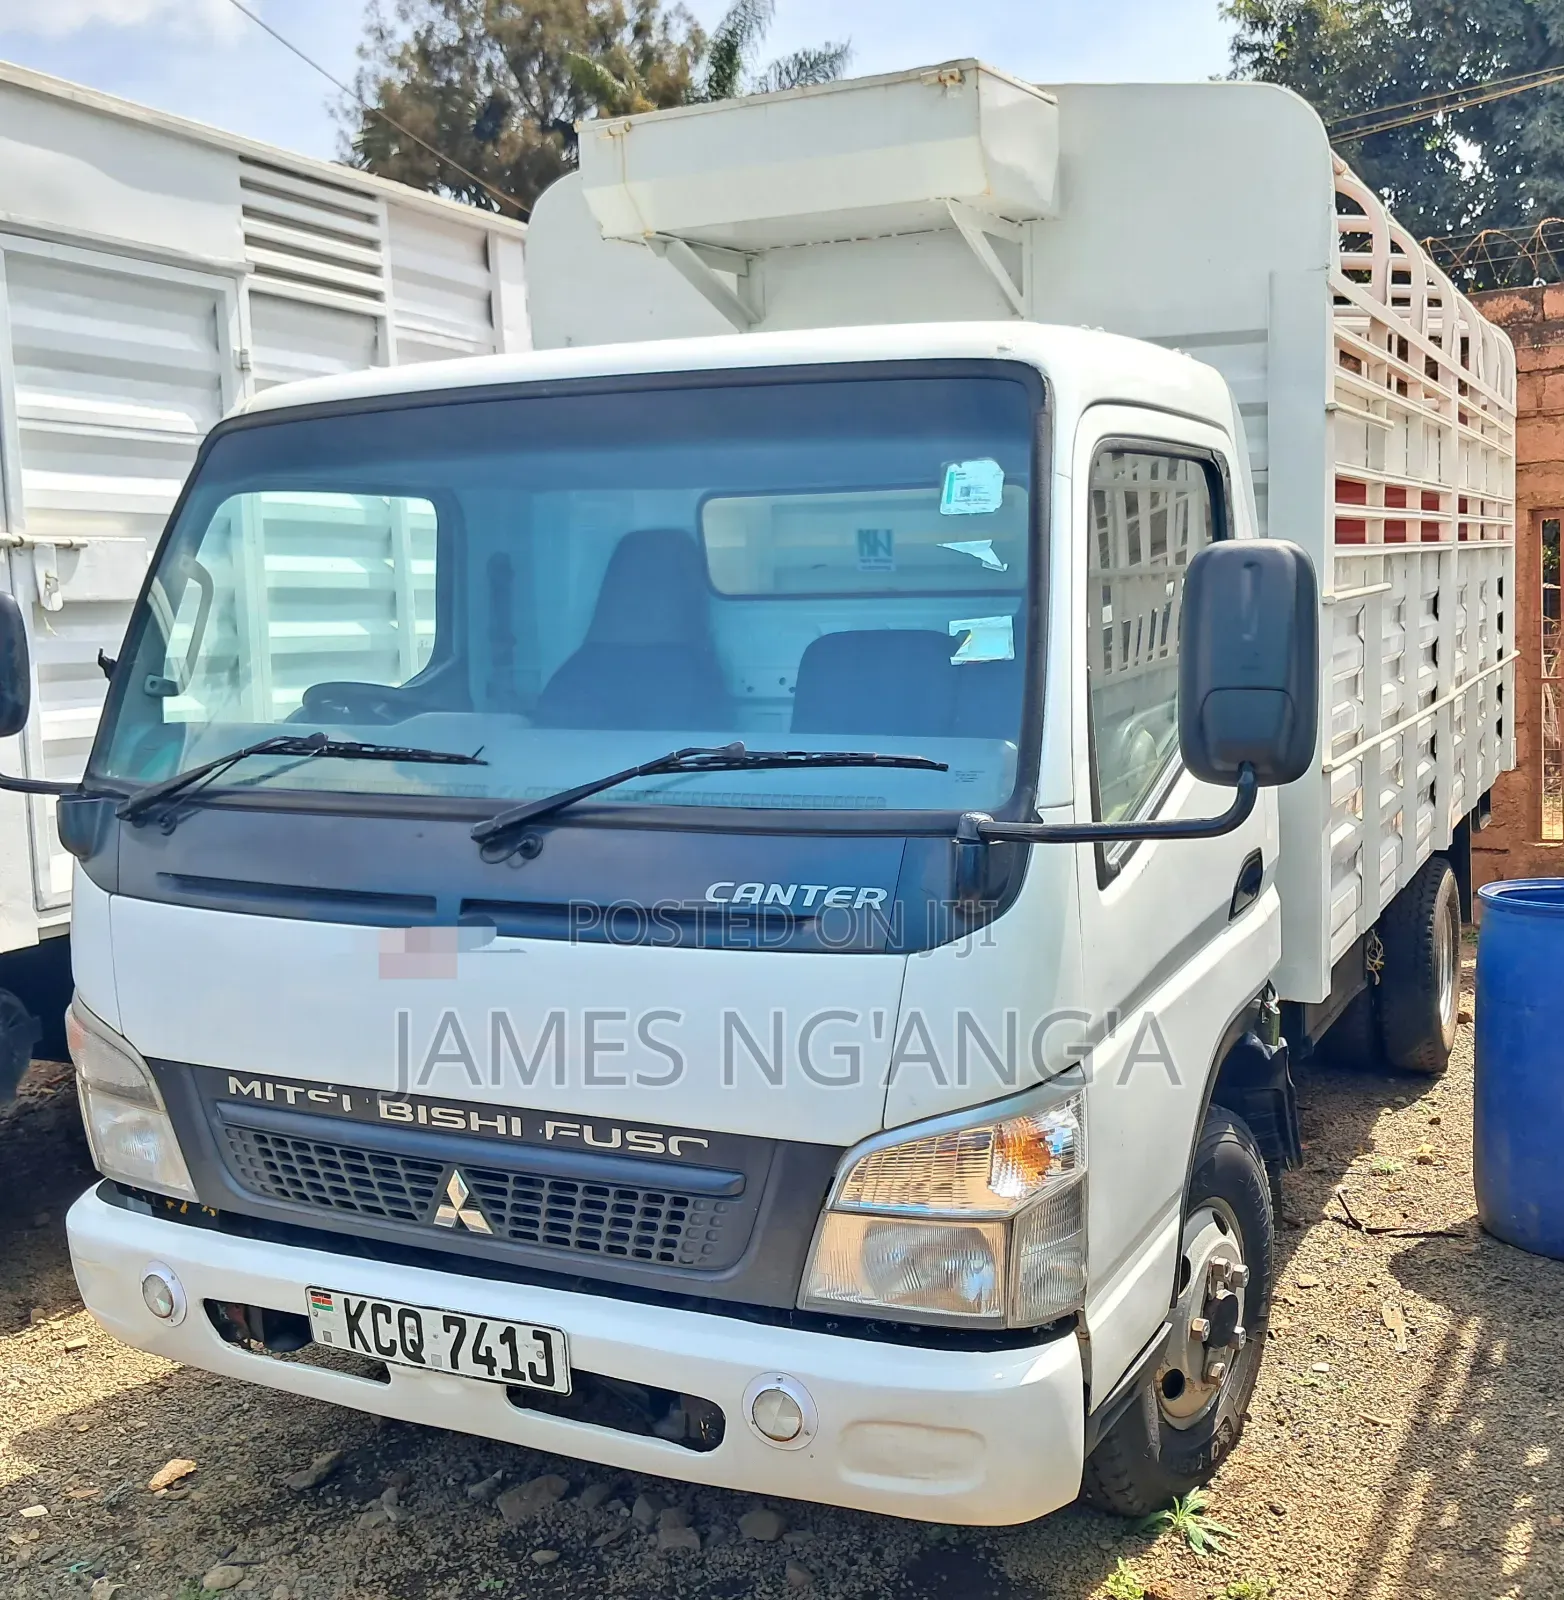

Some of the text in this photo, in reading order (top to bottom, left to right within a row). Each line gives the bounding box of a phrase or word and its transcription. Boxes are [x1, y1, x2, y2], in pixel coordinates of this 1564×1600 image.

[705, 881, 889, 911] CANTER
[344, 1297, 426, 1365] KCQ
[442, 1314, 556, 1387] 741J
